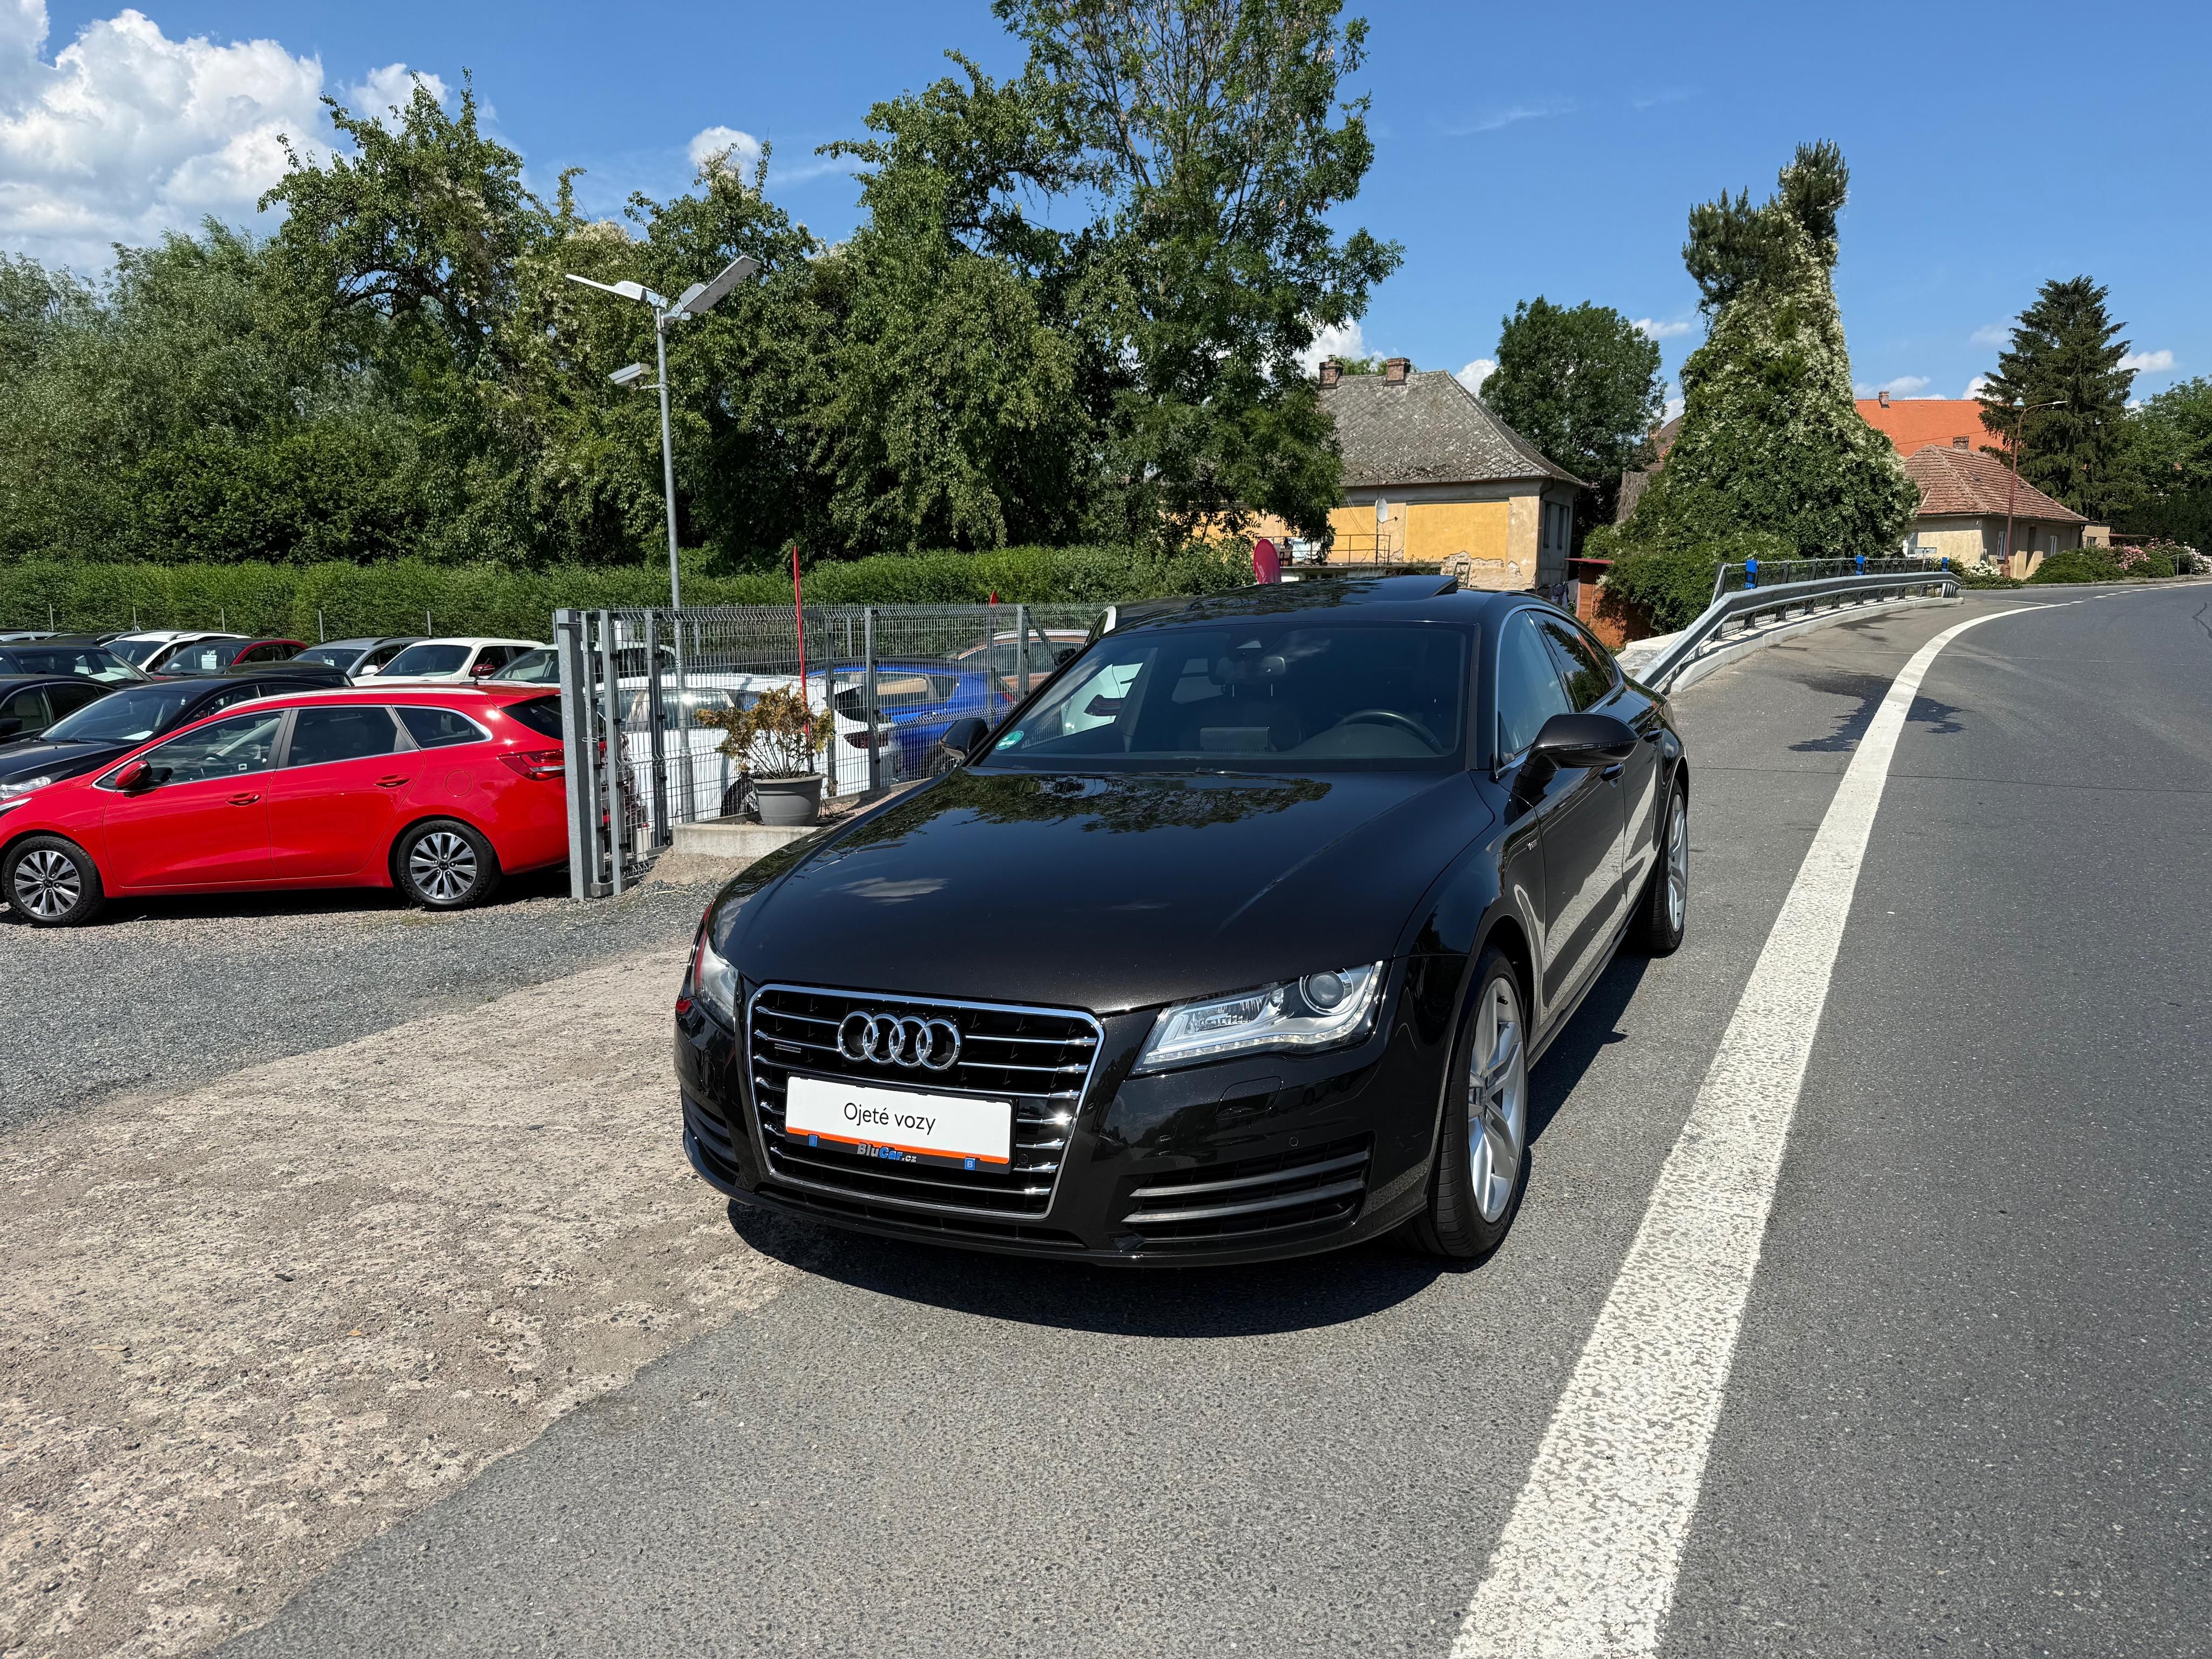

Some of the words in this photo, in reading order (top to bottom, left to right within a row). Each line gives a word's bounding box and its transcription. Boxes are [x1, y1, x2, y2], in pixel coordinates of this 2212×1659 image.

[844, 1102, 889, 1126] Ojeté
[894, 1114, 936, 1136] vozy
[857, 1143, 917, 1163] BluCar.cz
